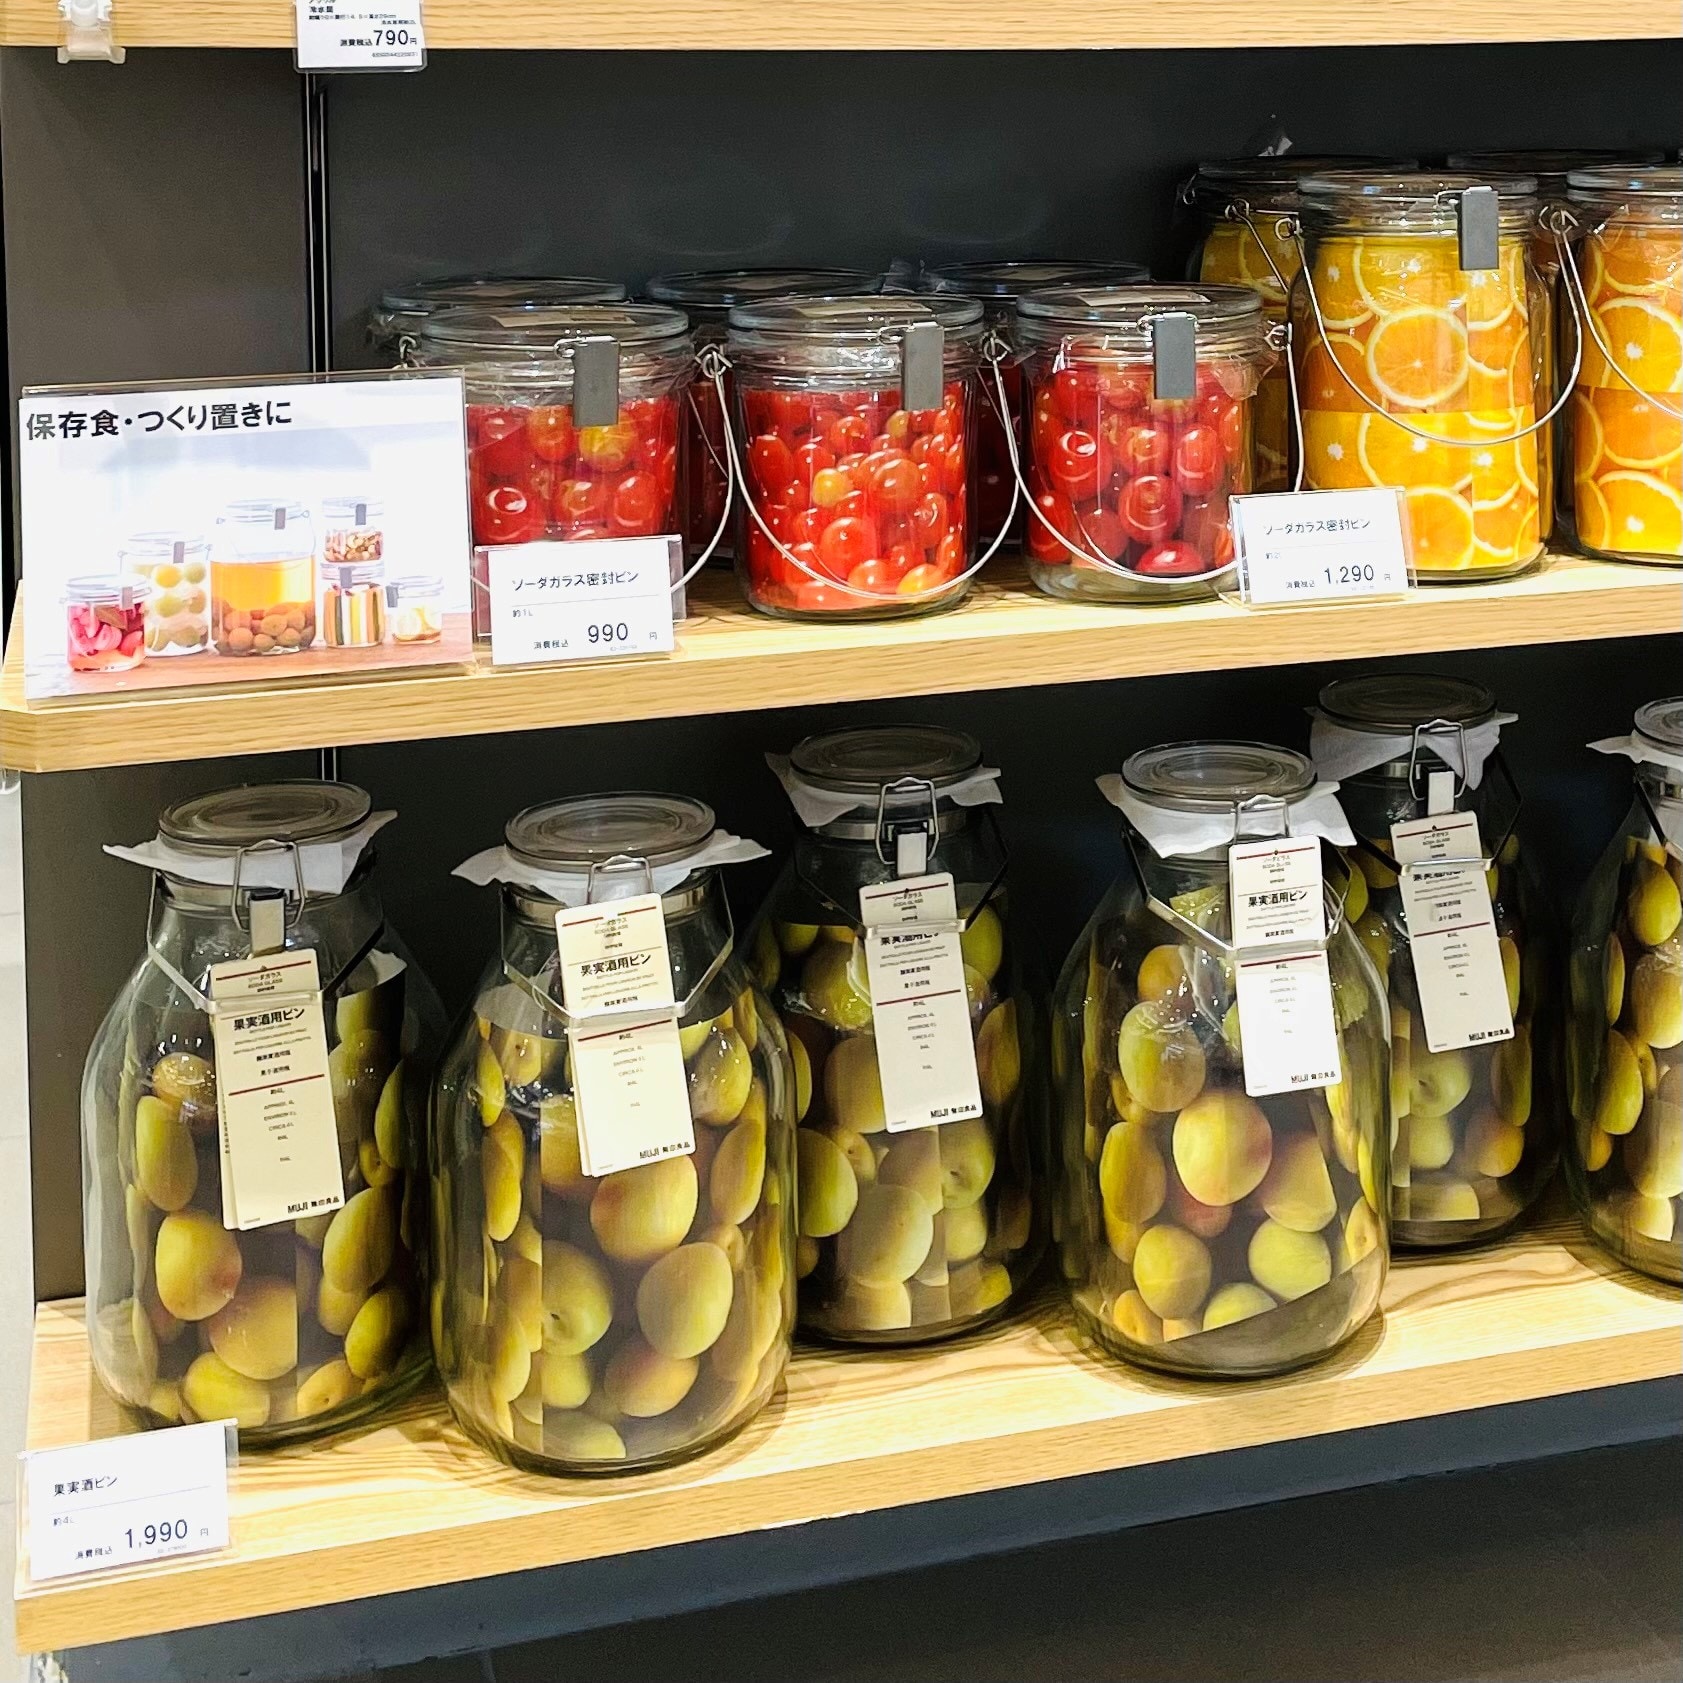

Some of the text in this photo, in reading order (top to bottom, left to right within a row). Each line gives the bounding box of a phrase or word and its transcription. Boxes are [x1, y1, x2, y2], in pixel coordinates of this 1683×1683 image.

[373, 30, 409, 46] 790
[26, 401, 292, 440] 保存食・つくり置きに
[512, 571, 639, 591] ソーダガラス密封ビン
[1324, 564, 1375, 585] 1,290
[533, 639, 569, 650] 消費税込
[587, 622, 629, 644] 990
[1248, 890, 1309, 907] 果実酒用ビン
[580, 953, 652, 977] 果実酒用ビン
[233, 1008, 305, 1031] 果実酒用ビン
[930, 1107, 949, 1119] MUJI
[639, 1145, 660, 1159] MUJI
[287, 1201, 309, 1215] MUJI
[53, 1476, 118, 1497] 果実酒ビン
[124, 1518, 188, 1549] 1,990
